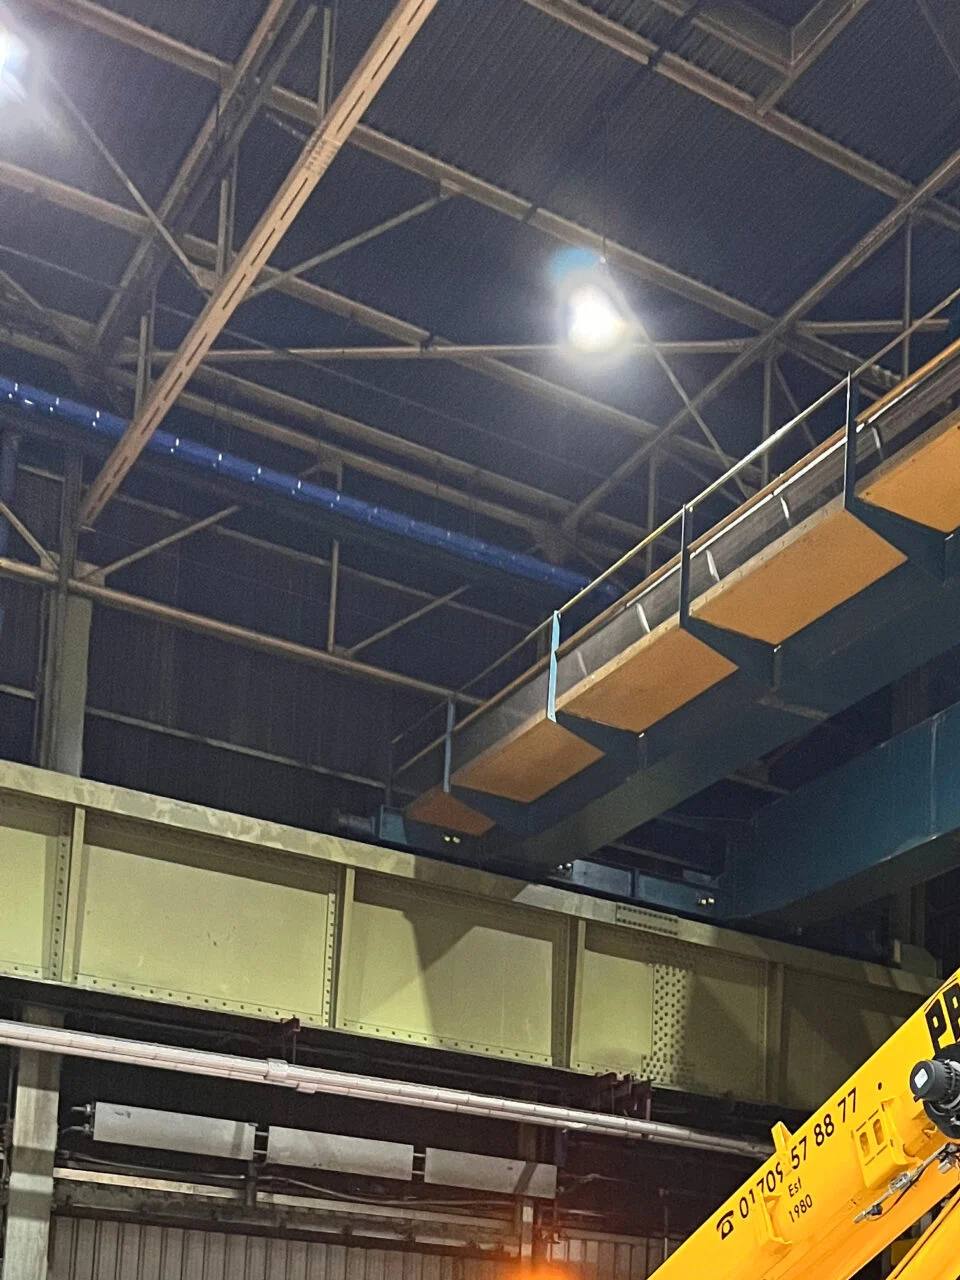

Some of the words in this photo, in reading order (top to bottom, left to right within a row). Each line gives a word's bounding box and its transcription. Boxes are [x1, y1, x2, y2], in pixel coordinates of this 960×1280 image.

[739, 1162, 784, 1219] 01709
[790, 1136, 807, 1170] 57
[813, 1113, 835, 1147] 88
[837, 1088, 857, 1123] 77
[788, 1194, 813, 1223] 1980
